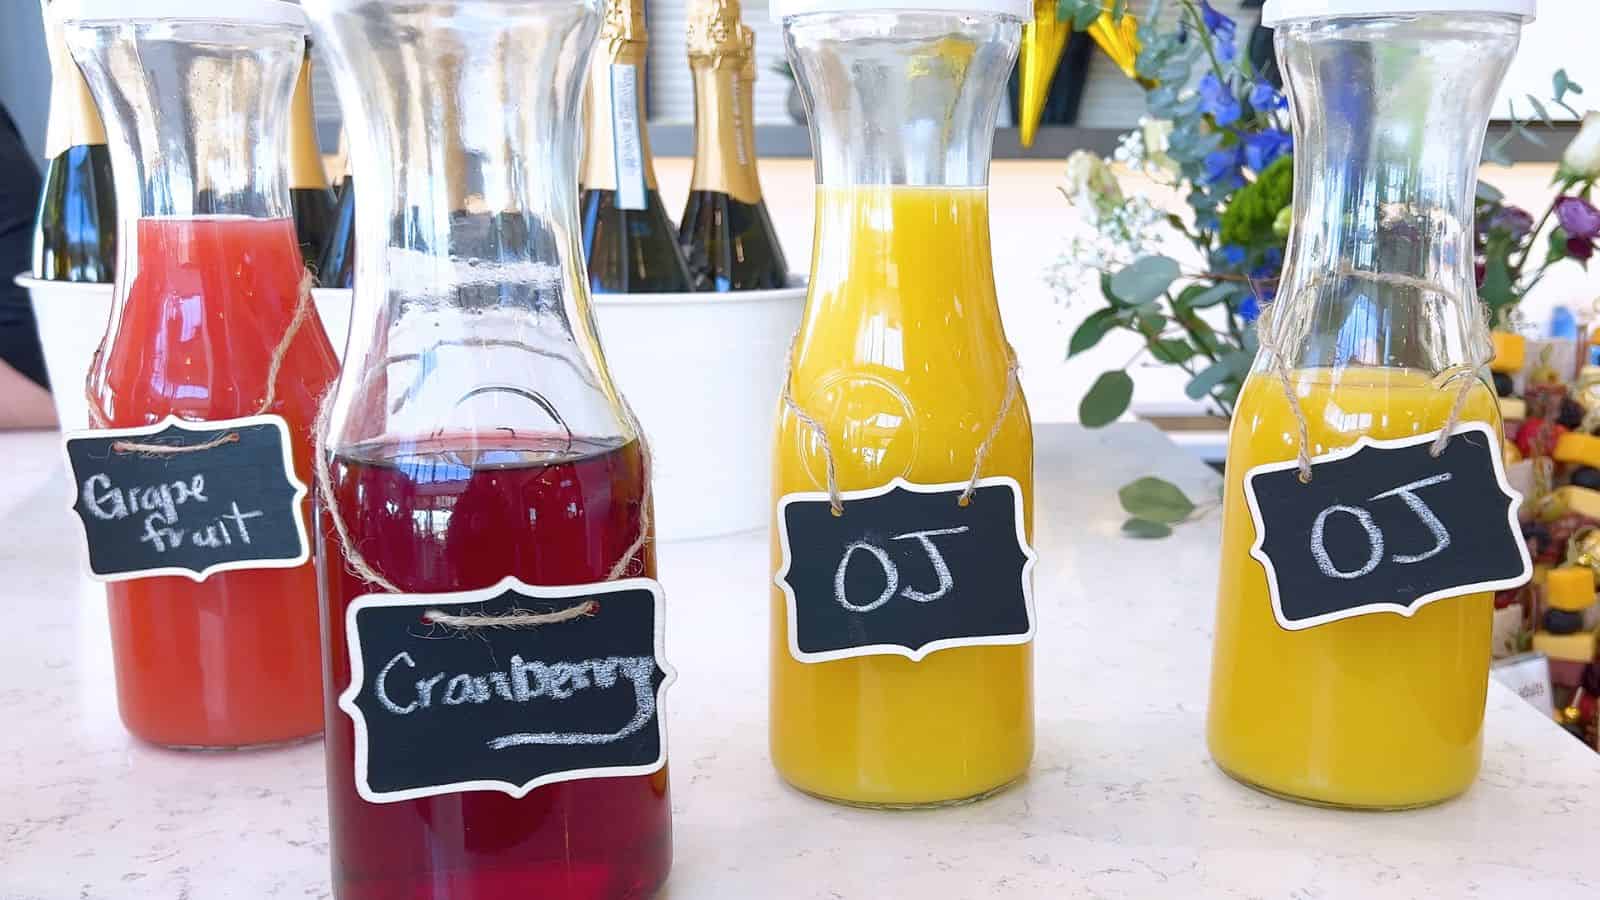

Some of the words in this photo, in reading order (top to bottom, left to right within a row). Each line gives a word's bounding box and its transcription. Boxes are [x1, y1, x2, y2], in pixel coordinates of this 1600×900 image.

[84, 472, 208, 524] Grape
[140, 501, 263, 552] fruit
[1311, 472, 1452, 579] OJ
[834, 526, 969, 612] OJ
[375, 652, 655, 750] Cranberry
